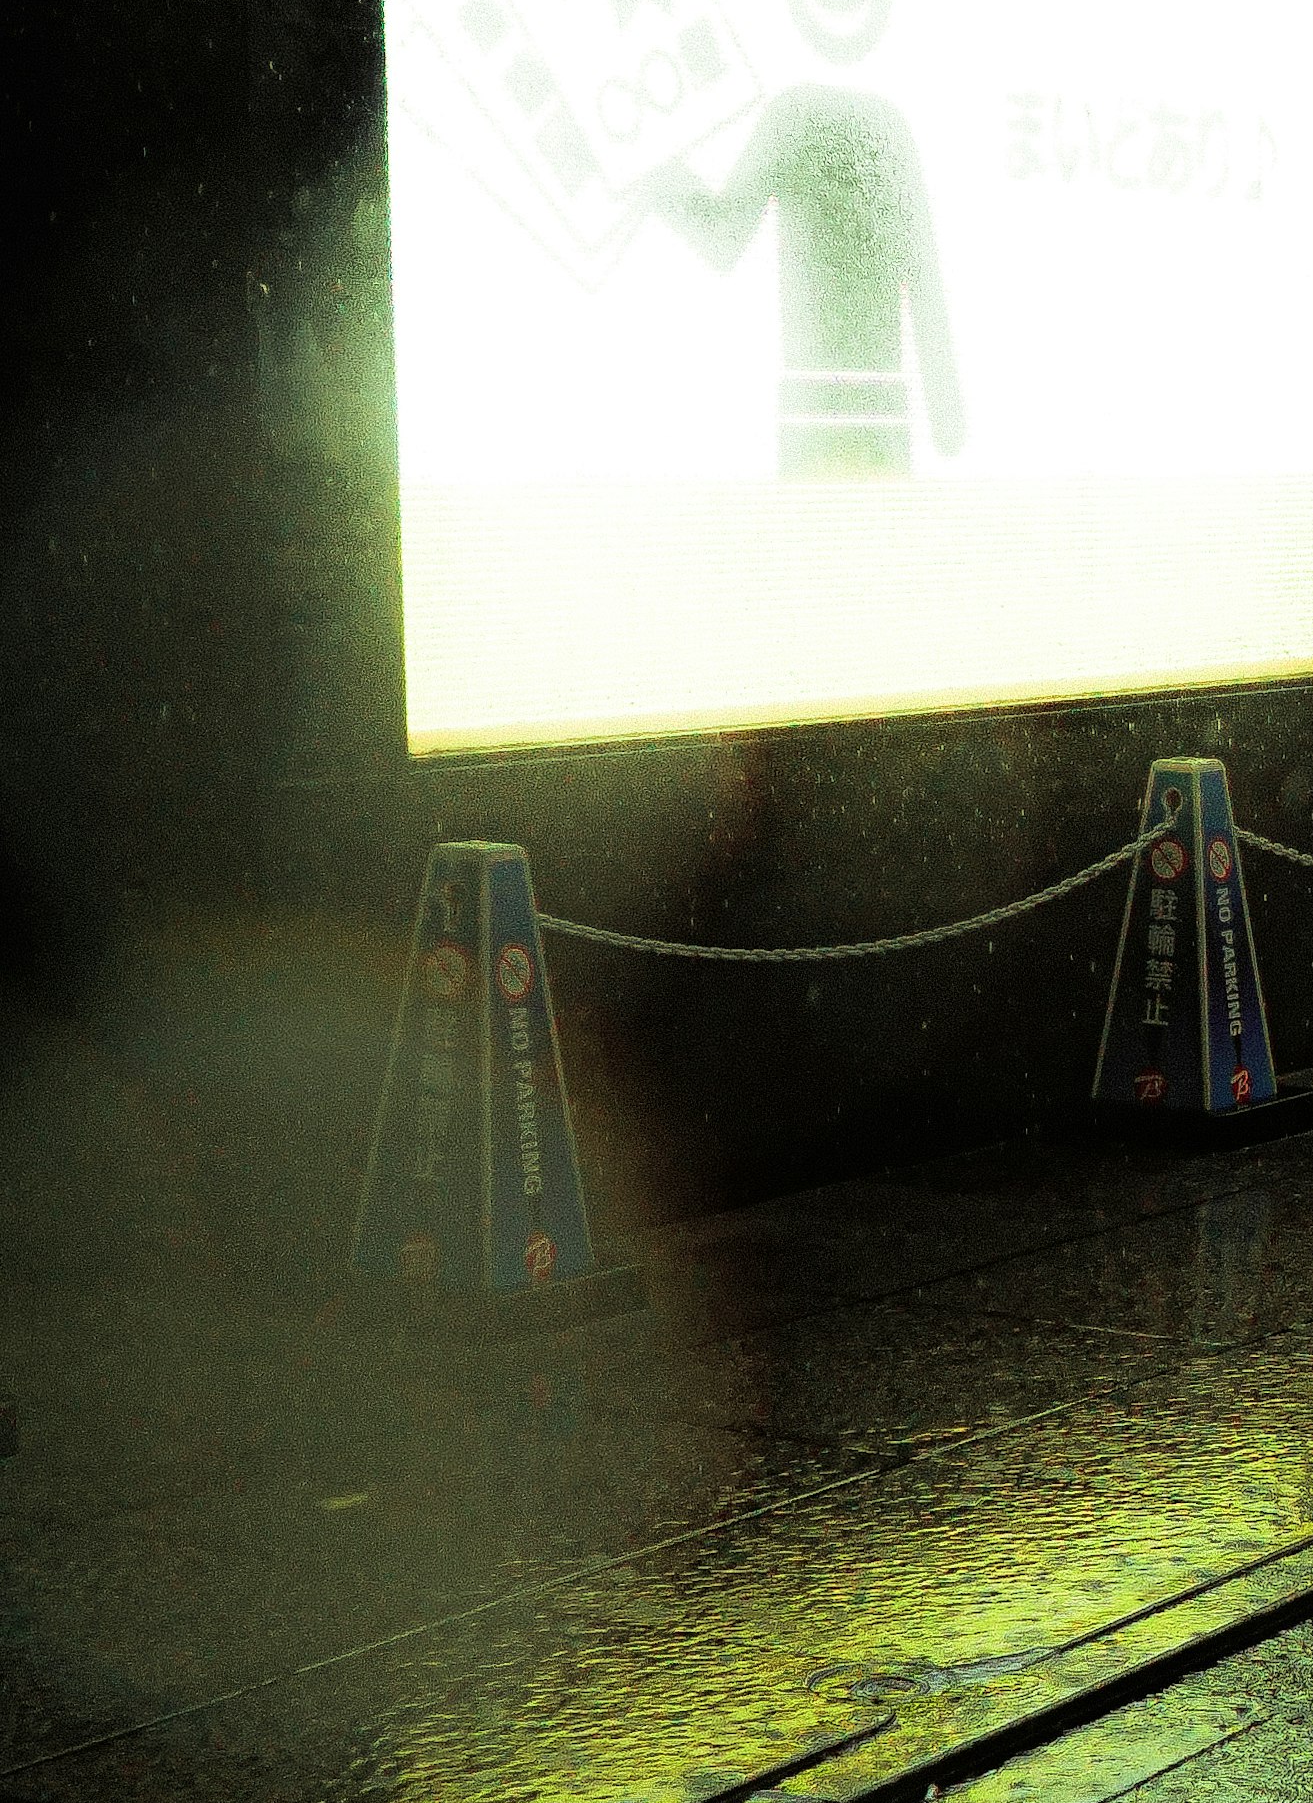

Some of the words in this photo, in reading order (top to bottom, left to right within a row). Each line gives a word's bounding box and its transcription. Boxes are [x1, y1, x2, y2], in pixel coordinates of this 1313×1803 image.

[1141, 888, 1179, 1028] 駐輪禁止
[1215, 886, 1233, 924] NO
[509, 1007, 531, 1052] NO
[1221, 930, 1242, 1038] PARKING
[513, 1059, 543, 1196] PARKING
